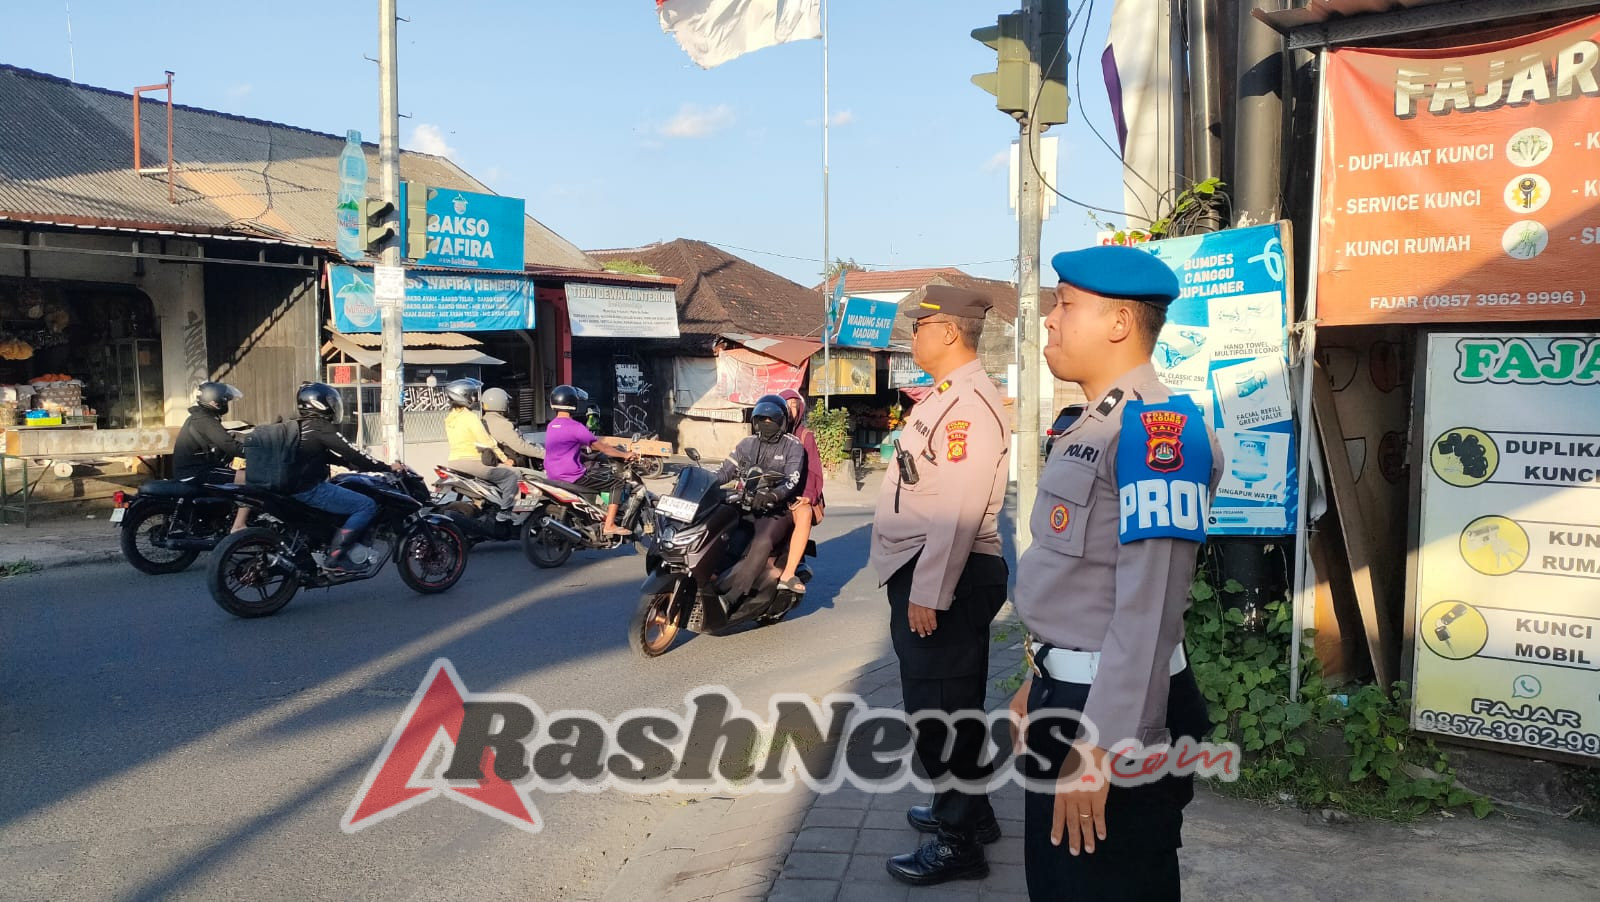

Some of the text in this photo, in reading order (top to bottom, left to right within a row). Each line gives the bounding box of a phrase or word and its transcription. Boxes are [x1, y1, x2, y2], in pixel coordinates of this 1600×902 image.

[1395, 40, 1600, 119] FAJAR
[1349, 149, 1431, 171] DUPLIKAT
[1436, 144, 1494, 164] KUNCI
[1346, 194, 1419, 214] SERVICE
[1424, 190, 1481, 208] KUNCI
[427, 214, 490, 236] BAKSO
[1345, 239, 1399, 257] KUNCI
[1404, 235, 1471, 254] RUMAH
[1184, 253, 1234, 271] BUMDES
[1184, 267, 1235, 285] CANGGU
[428, 278, 472, 291] WAFIRA
[474, 279, 520, 293] (JEMBER)
[573, 286, 672, 303] TIRAI DEWATA INTERIOR
[1370, 296, 1418, 309] FAJAR
[1423, 294, 1470, 310] (0857
[1477, 292, 1521, 306] 3962
[1527, 290, 1574, 305] 9996
[847, 314, 892, 329] WARUNG SATE
[852, 327, 879, 340] MADURA
[1215, 348, 1254, 357] MULTIFOLD
[1244, 341, 1269, 349] TOWEL
[1236, 406, 1282, 420] FACIAL REFILL
[1261, 412, 1283, 422] VALUE
[912, 419, 930, 438] POLRI
[1150, 425, 1179, 433] BALI
[1063, 443, 1099, 463] POLRI
[1218, 488, 1278, 500] SINGAPUR WATER
[1542, 555, 1600, 574] RUM
[1515, 618, 1592, 640] KUNCI
[1515, 643, 1591, 665] MOBIL
[1471, 698, 1581, 728] FAJAR
